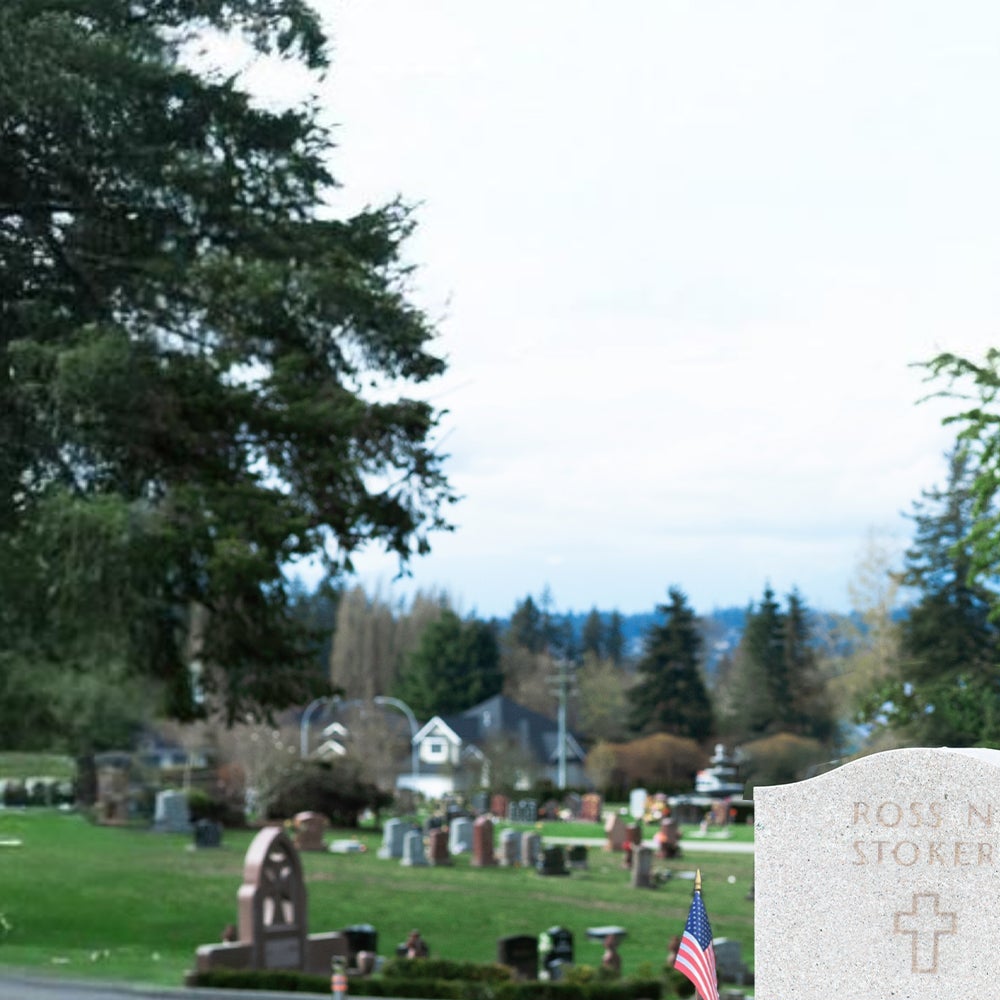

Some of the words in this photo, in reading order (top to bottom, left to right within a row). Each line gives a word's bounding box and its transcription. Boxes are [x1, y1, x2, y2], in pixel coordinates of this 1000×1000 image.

[853, 801, 944, 828] ROSS
[967, 803, 992, 828] N
[852, 840, 994, 867] STOKER
